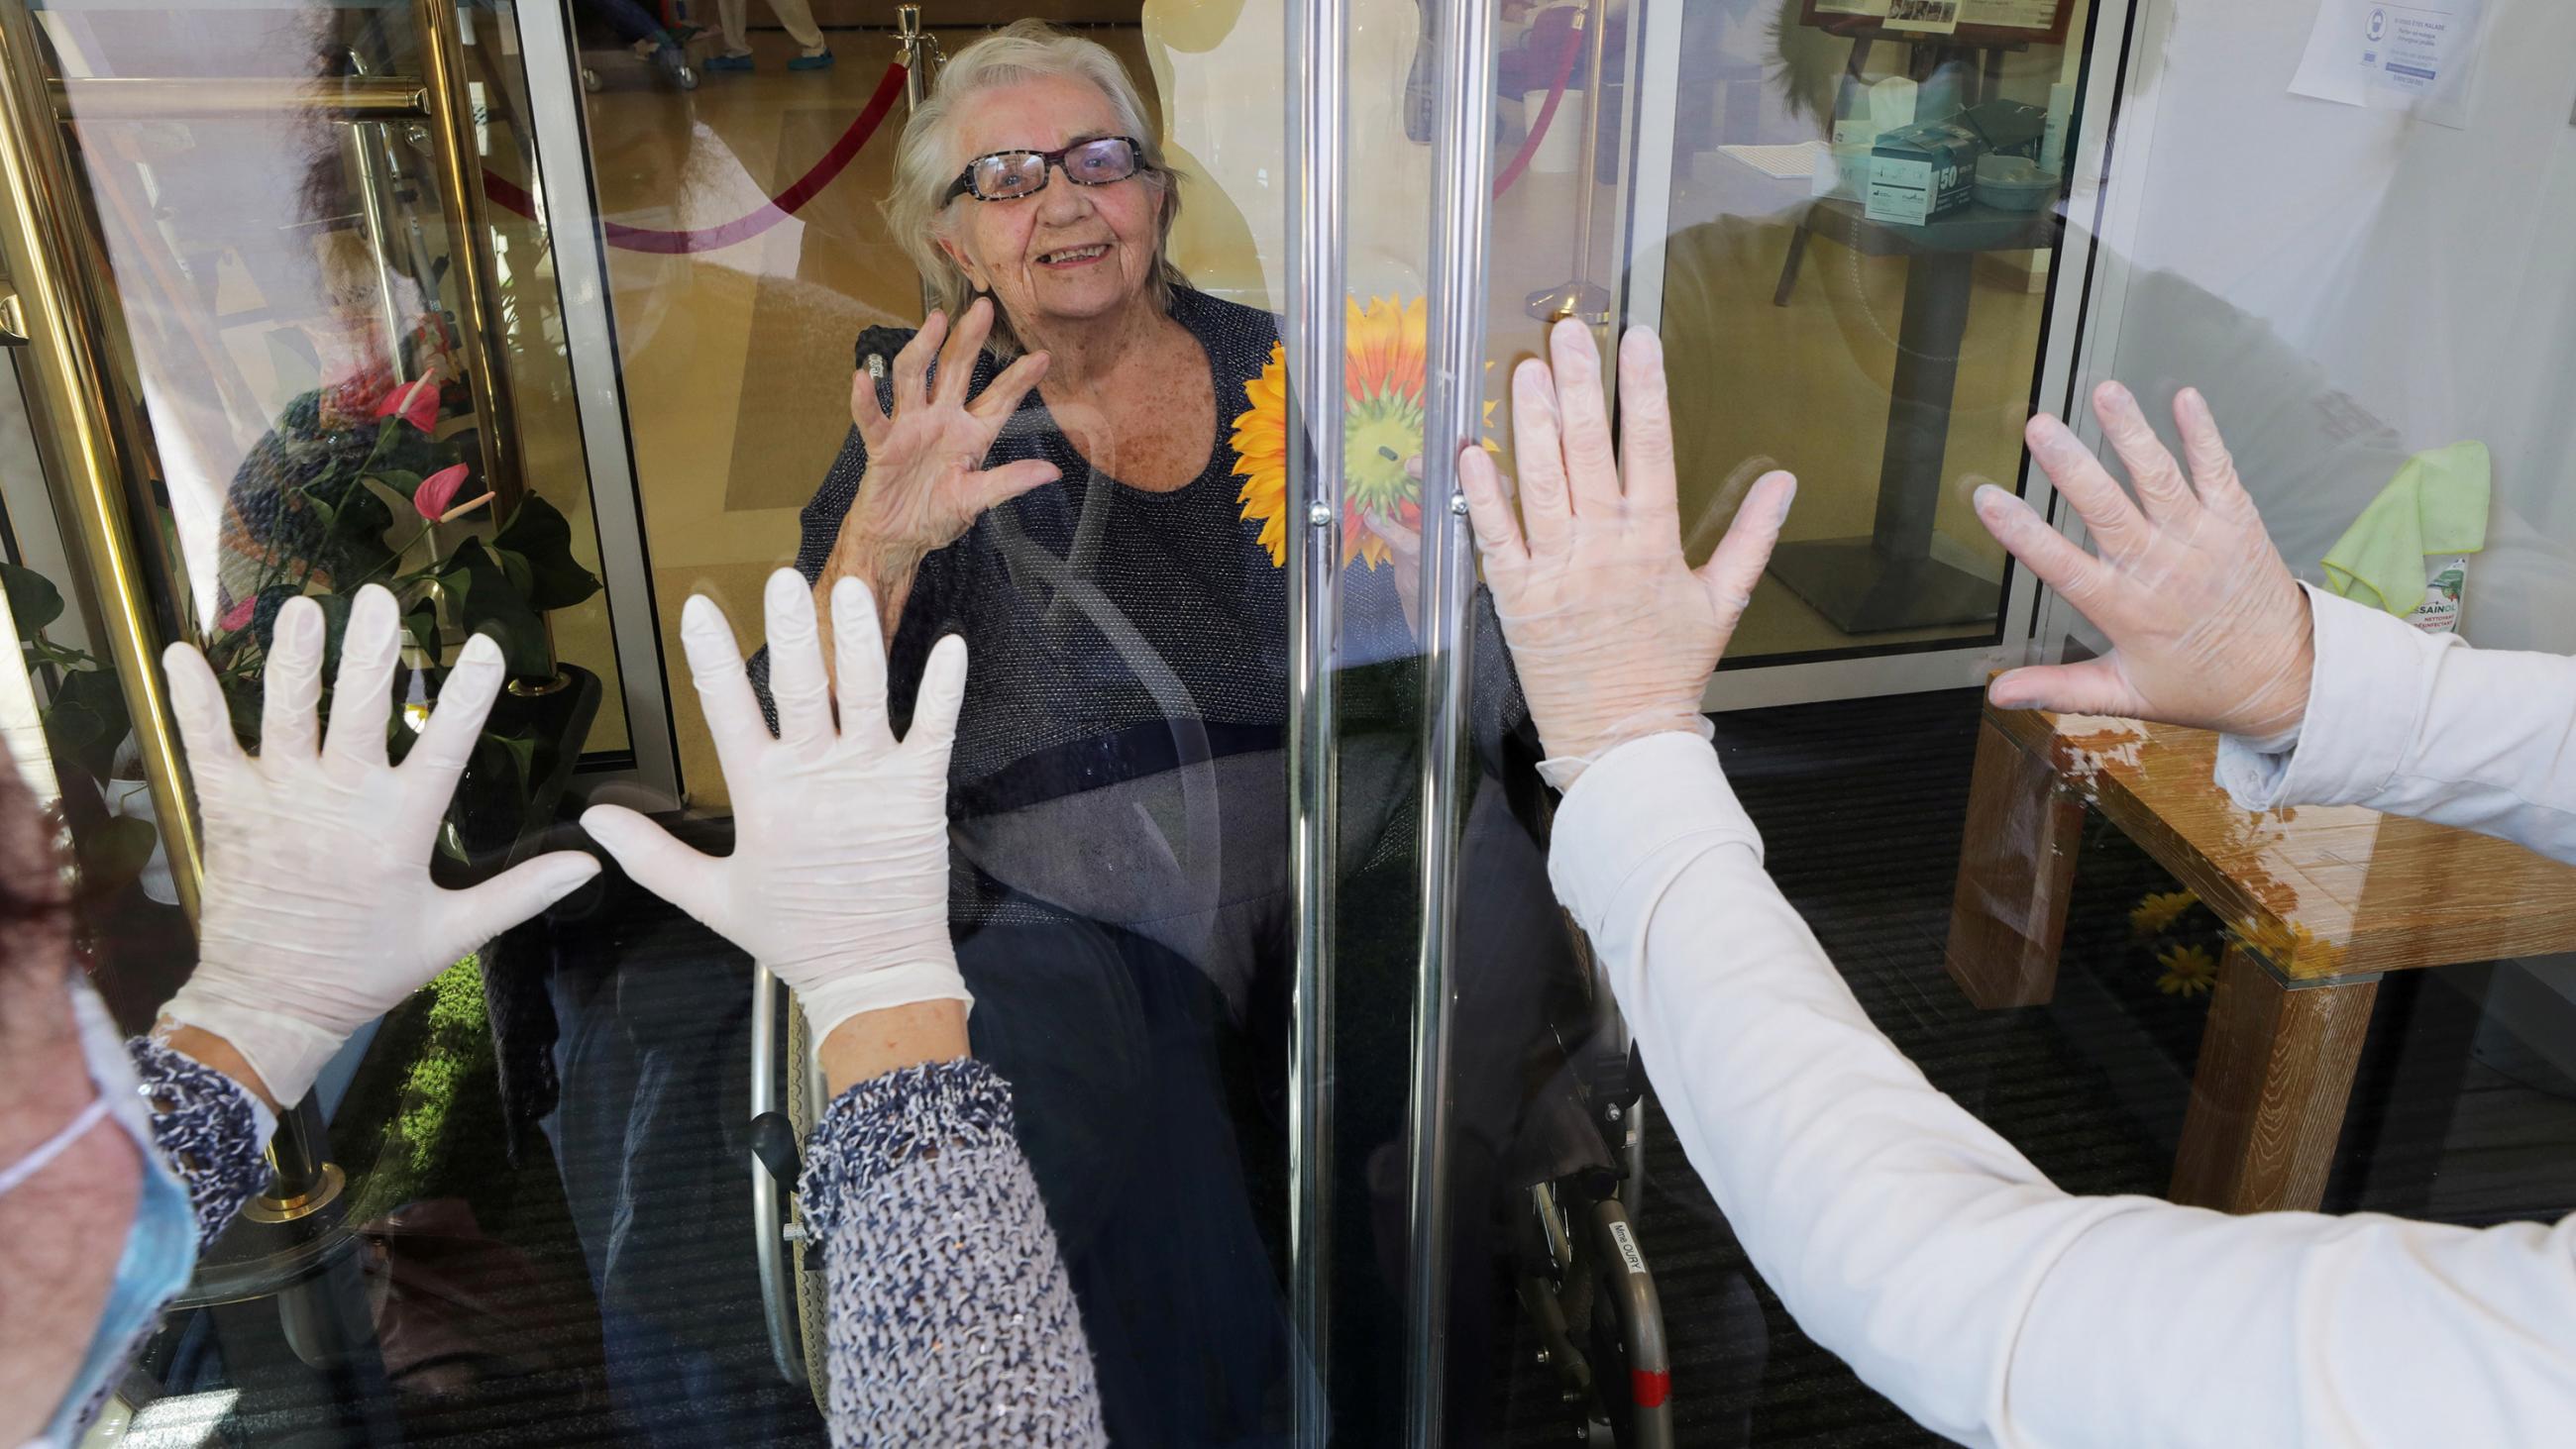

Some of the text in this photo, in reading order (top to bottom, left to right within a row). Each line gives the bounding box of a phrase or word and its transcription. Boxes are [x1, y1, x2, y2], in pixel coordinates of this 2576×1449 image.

[1940, 165, 1958, 190] 50
[1614, 1224, 1642, 1269] Mme OURY
